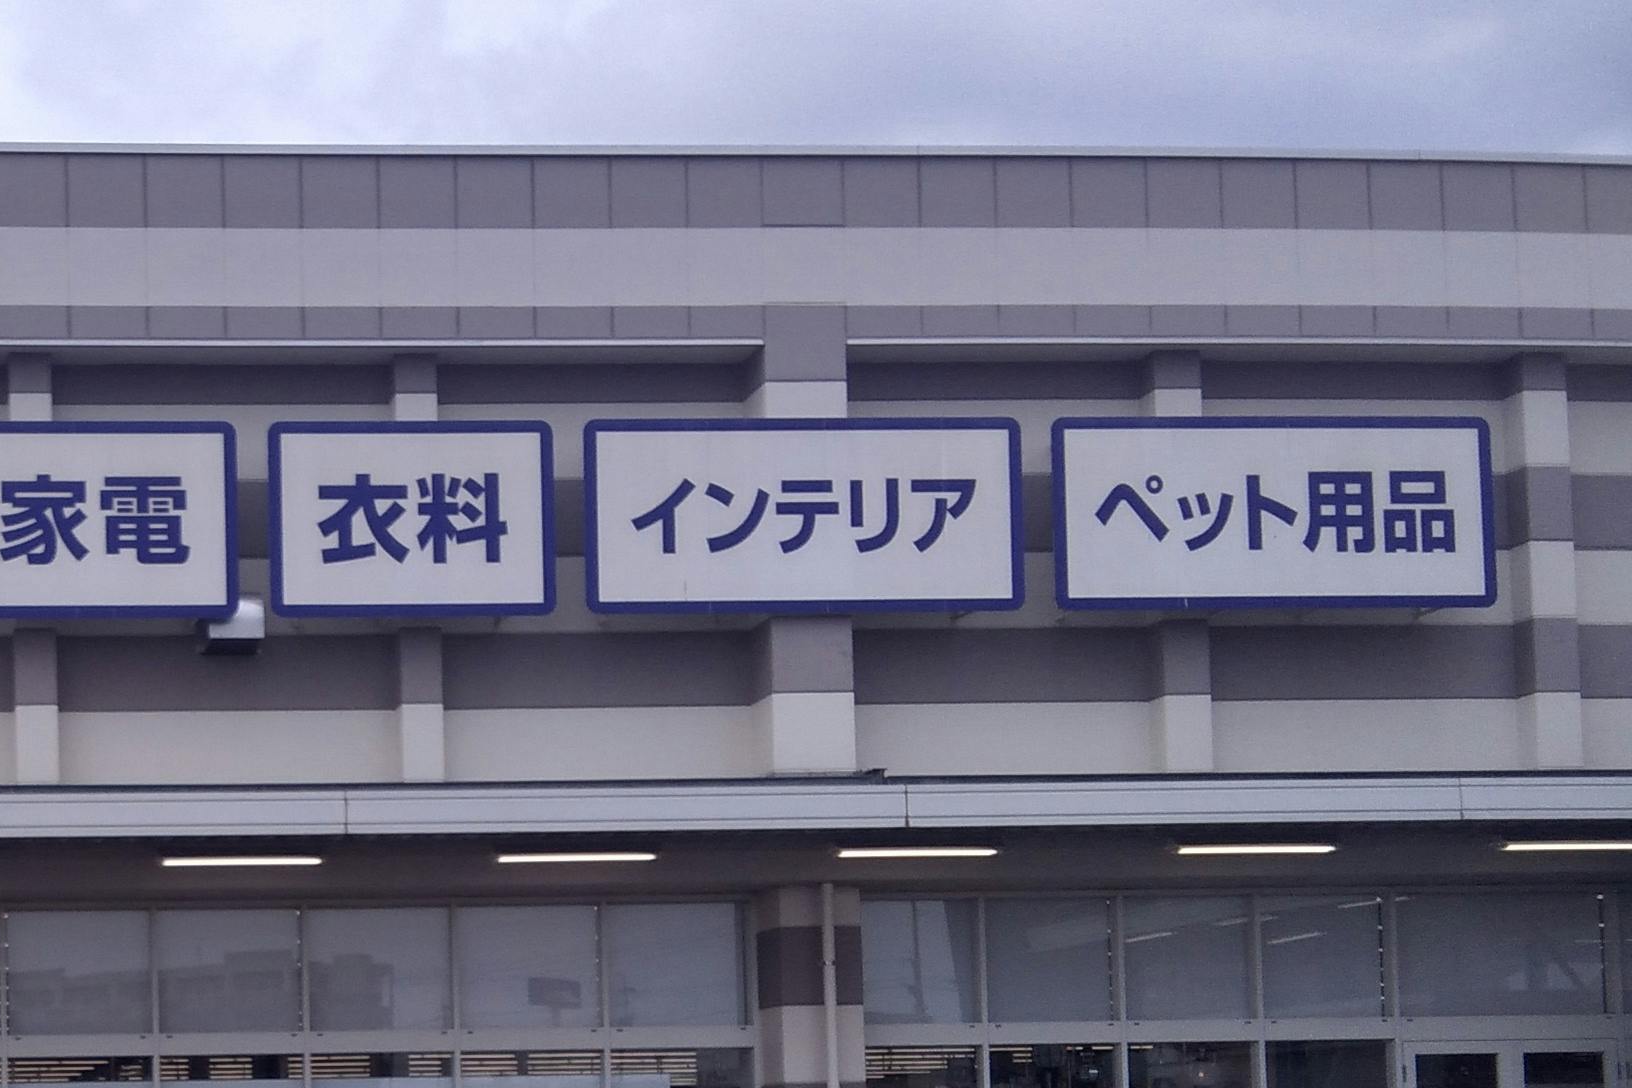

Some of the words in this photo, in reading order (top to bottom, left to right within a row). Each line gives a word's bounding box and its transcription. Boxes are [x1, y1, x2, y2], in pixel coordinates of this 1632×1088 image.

[0, 474, 190, 565] 家電
[318, 473, 508, 564] 衣料
[632, 478, 976, 553] インテリア
[1095, 471, 1456, 553] ペット用品
